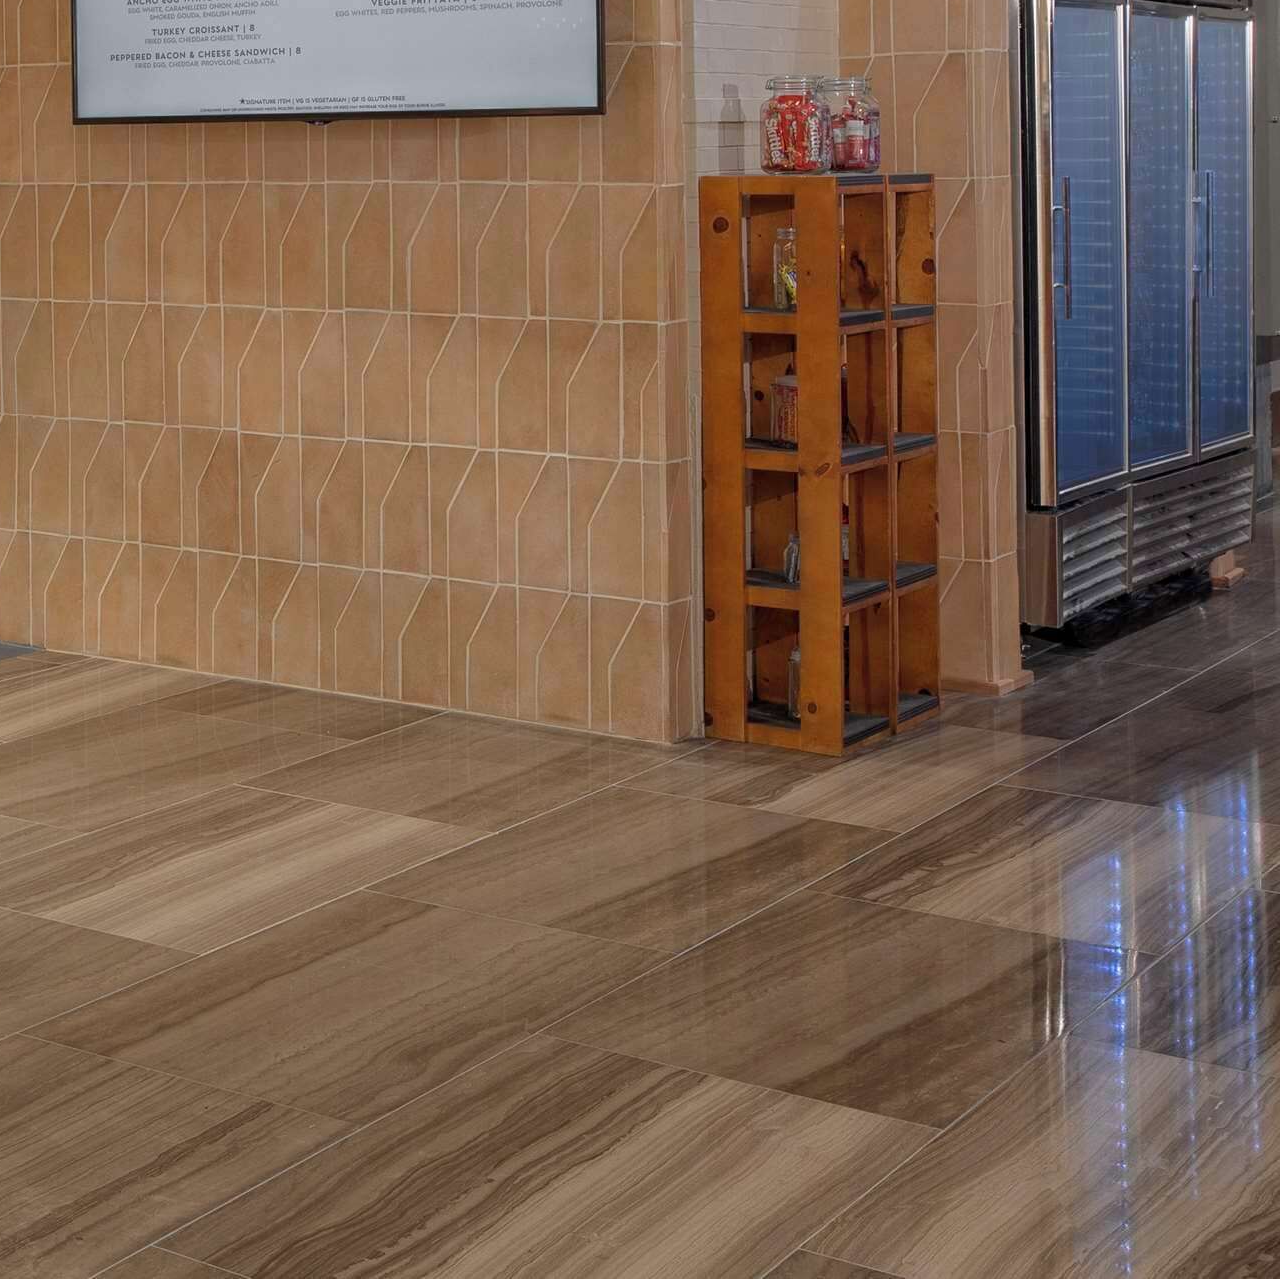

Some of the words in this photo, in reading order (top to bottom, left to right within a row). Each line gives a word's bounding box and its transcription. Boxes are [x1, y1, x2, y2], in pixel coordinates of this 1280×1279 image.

[152, 27, 185, 36] TURKEY
[188, 24, 239, 34] CROISSANT
[248, 23, 255, 31] 8
[110, 52, 151, 61] PEPPERED
[155, 51, 185, 60] BACON
[197, 49, 231, 58] CHEESE
[234, 47, 285, 57] SANDWICH
[295, 46, 301, 54] 8
[765, 118, 782, 164] Skittles
